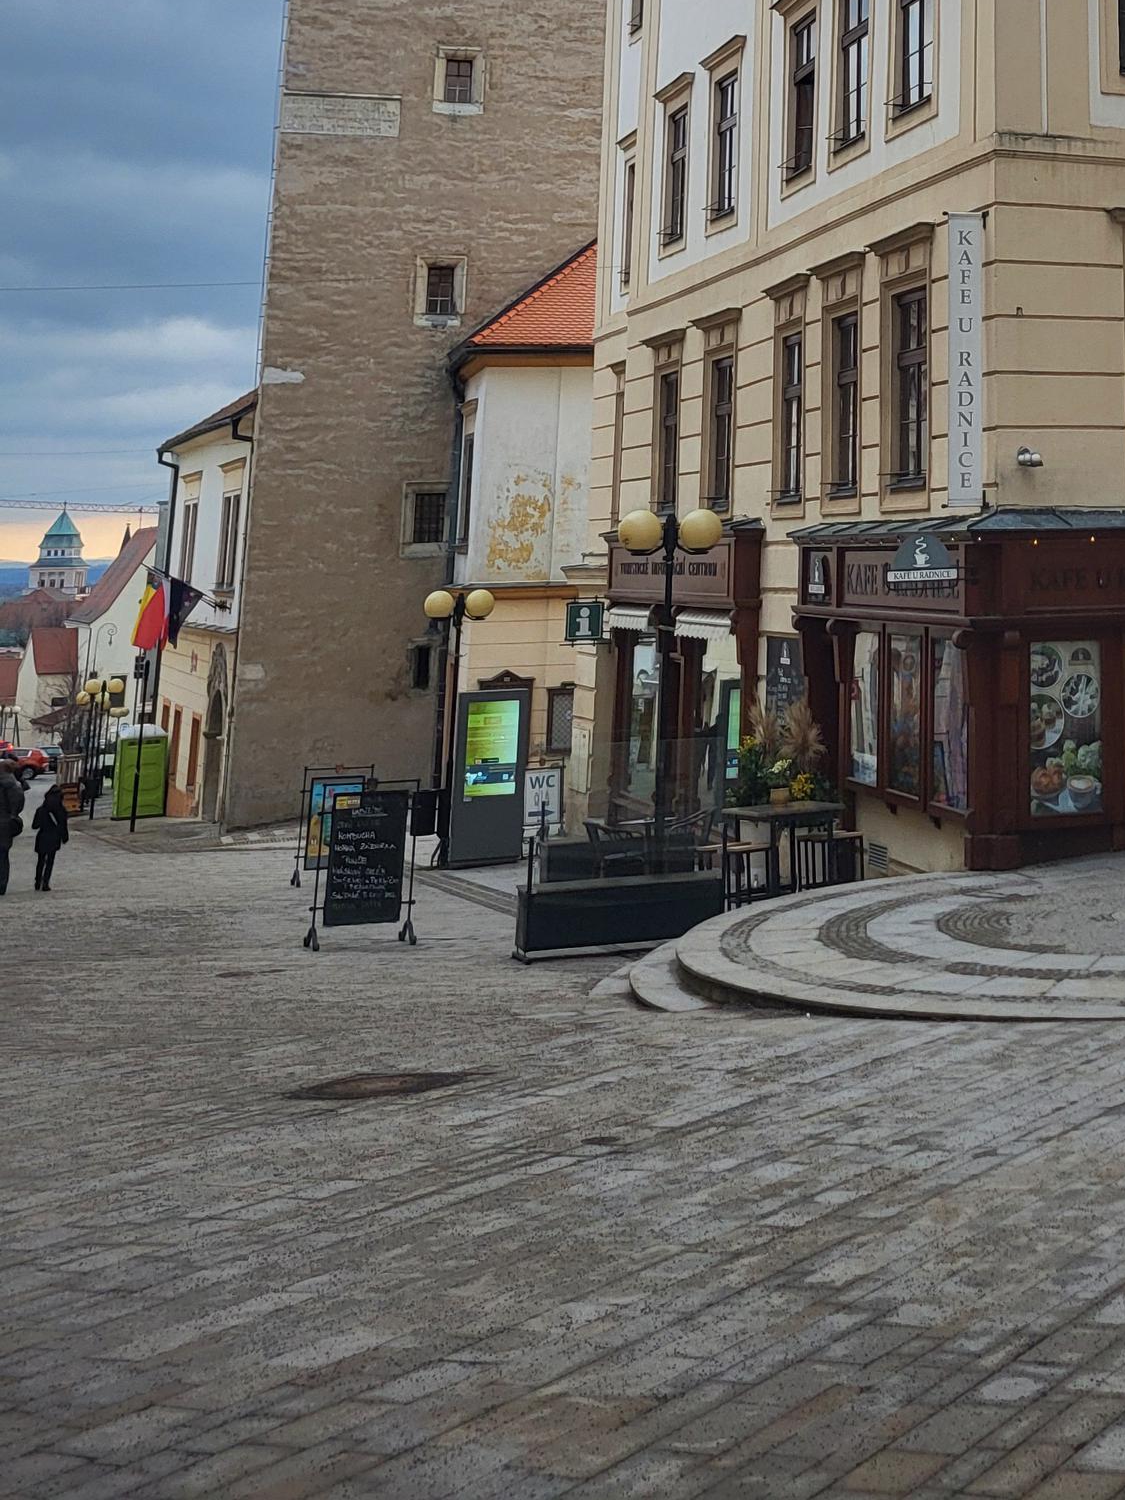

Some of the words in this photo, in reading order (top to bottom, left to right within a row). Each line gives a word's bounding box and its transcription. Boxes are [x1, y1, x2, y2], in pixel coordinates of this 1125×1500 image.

[957, 229, 974, 305] KAFE
[958, 317, 974, 333] U
[957, 351, 975, 489] RADNICE
[651, 556, 686, 575] INFOAČNÍ
[893, 571, 911, 580] KAFE
[913, 571, 918, 579] U
[919, 570, 951, 579] RADNICE
[847, 563, 878, 596] KAFE
[529, 774, 556, 789] WC
